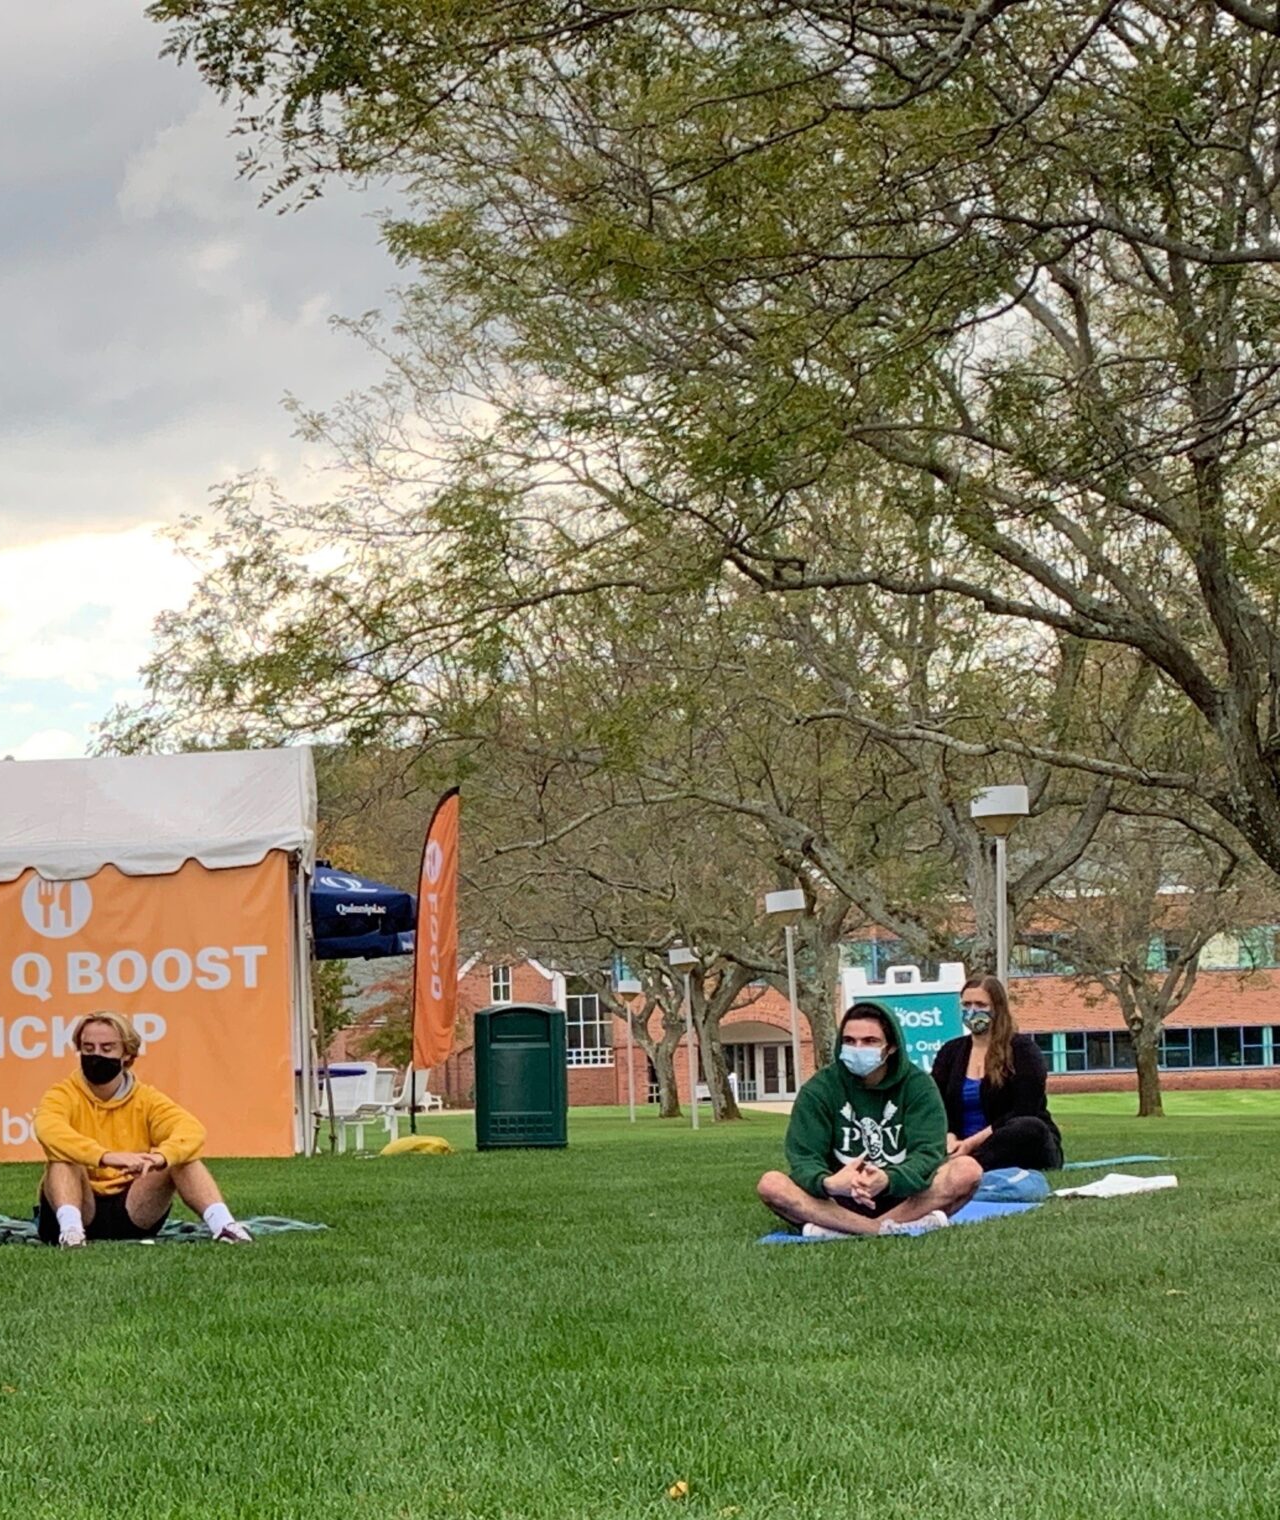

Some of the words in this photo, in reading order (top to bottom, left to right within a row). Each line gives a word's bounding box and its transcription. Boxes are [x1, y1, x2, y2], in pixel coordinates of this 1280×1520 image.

[427, 892, 442, 1001] FOOD
[11, 952, 52, 1001] Q
[67, 946, 267, 995] BOOST
[895, 1006, 943, 1027] ost
[915, 1039, 945, 1052] Ord
